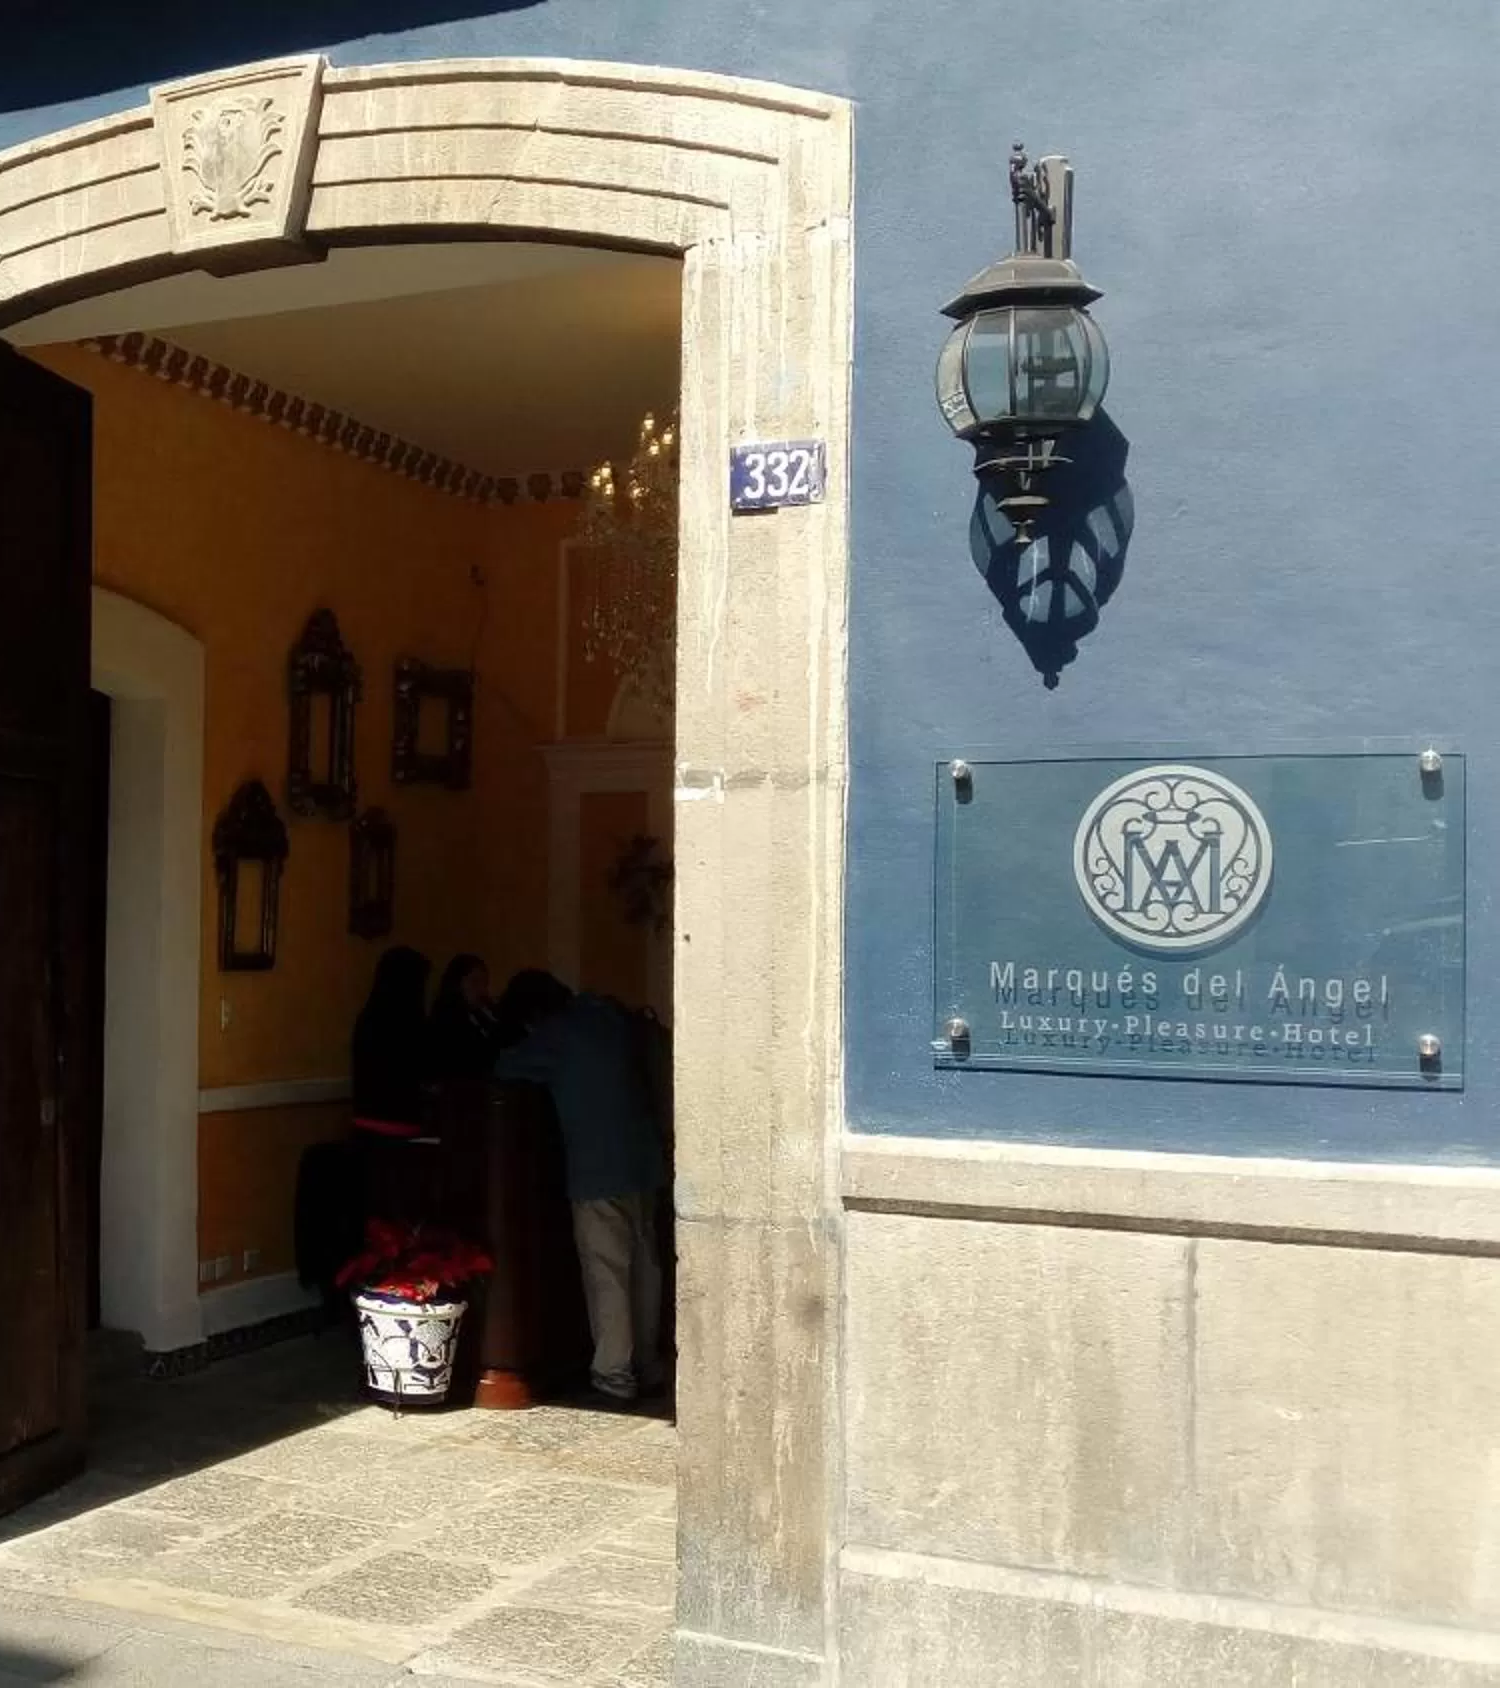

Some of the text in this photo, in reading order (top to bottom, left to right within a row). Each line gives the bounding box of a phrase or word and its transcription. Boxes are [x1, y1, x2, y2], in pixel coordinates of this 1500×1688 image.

[744, 449, 809, 499] 332
[990, 961, 1388, 1007] Marqués del Ángel
